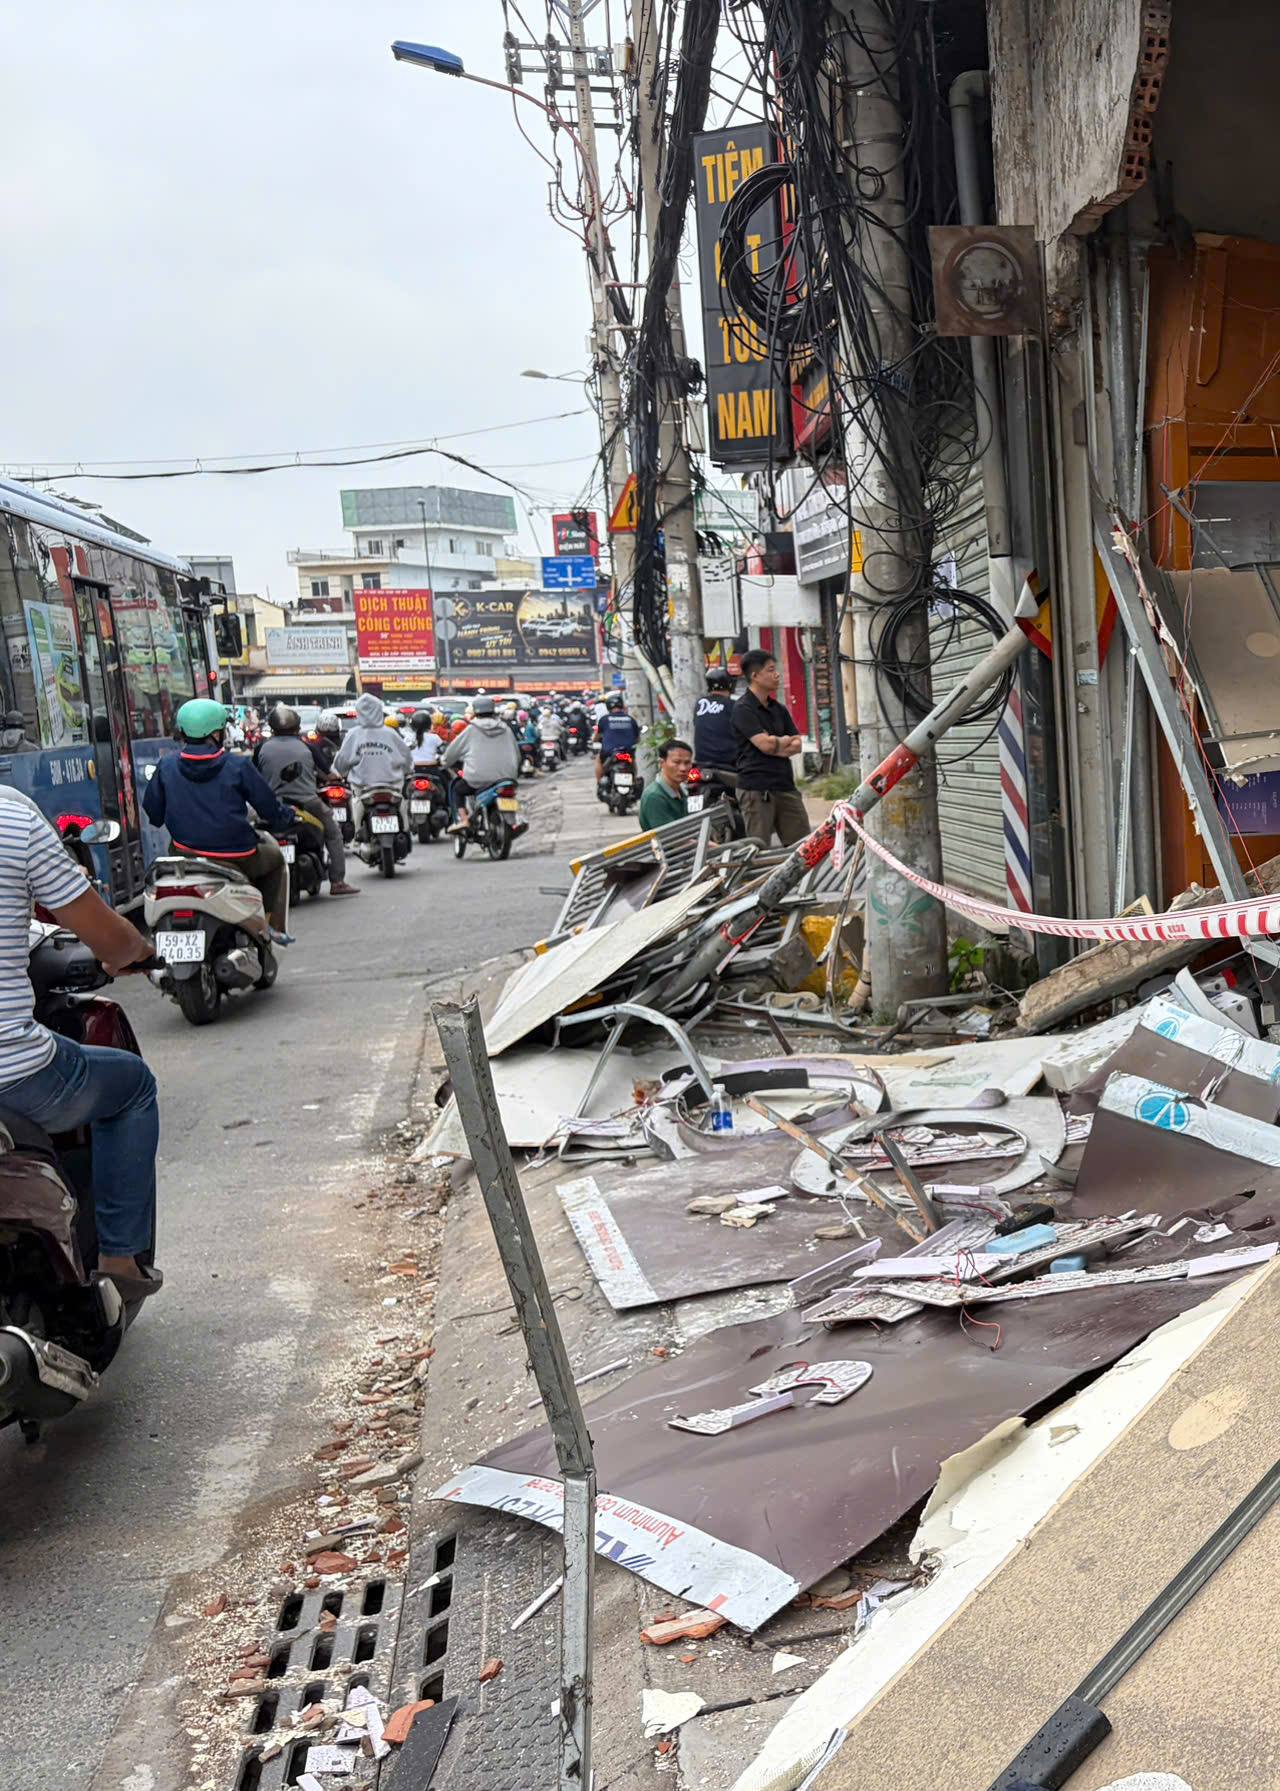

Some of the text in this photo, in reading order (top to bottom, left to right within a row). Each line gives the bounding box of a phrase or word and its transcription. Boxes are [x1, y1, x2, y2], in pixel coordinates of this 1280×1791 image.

[717, 388, 777, 441] NAM
[392, 593, 427, 613] THUẬT
[476, 602, 514, 612] K-CAR
[358, 613, 432, 632] CÔNG CHỨNG
[612, 1504, 685, 1551] Aluminum
